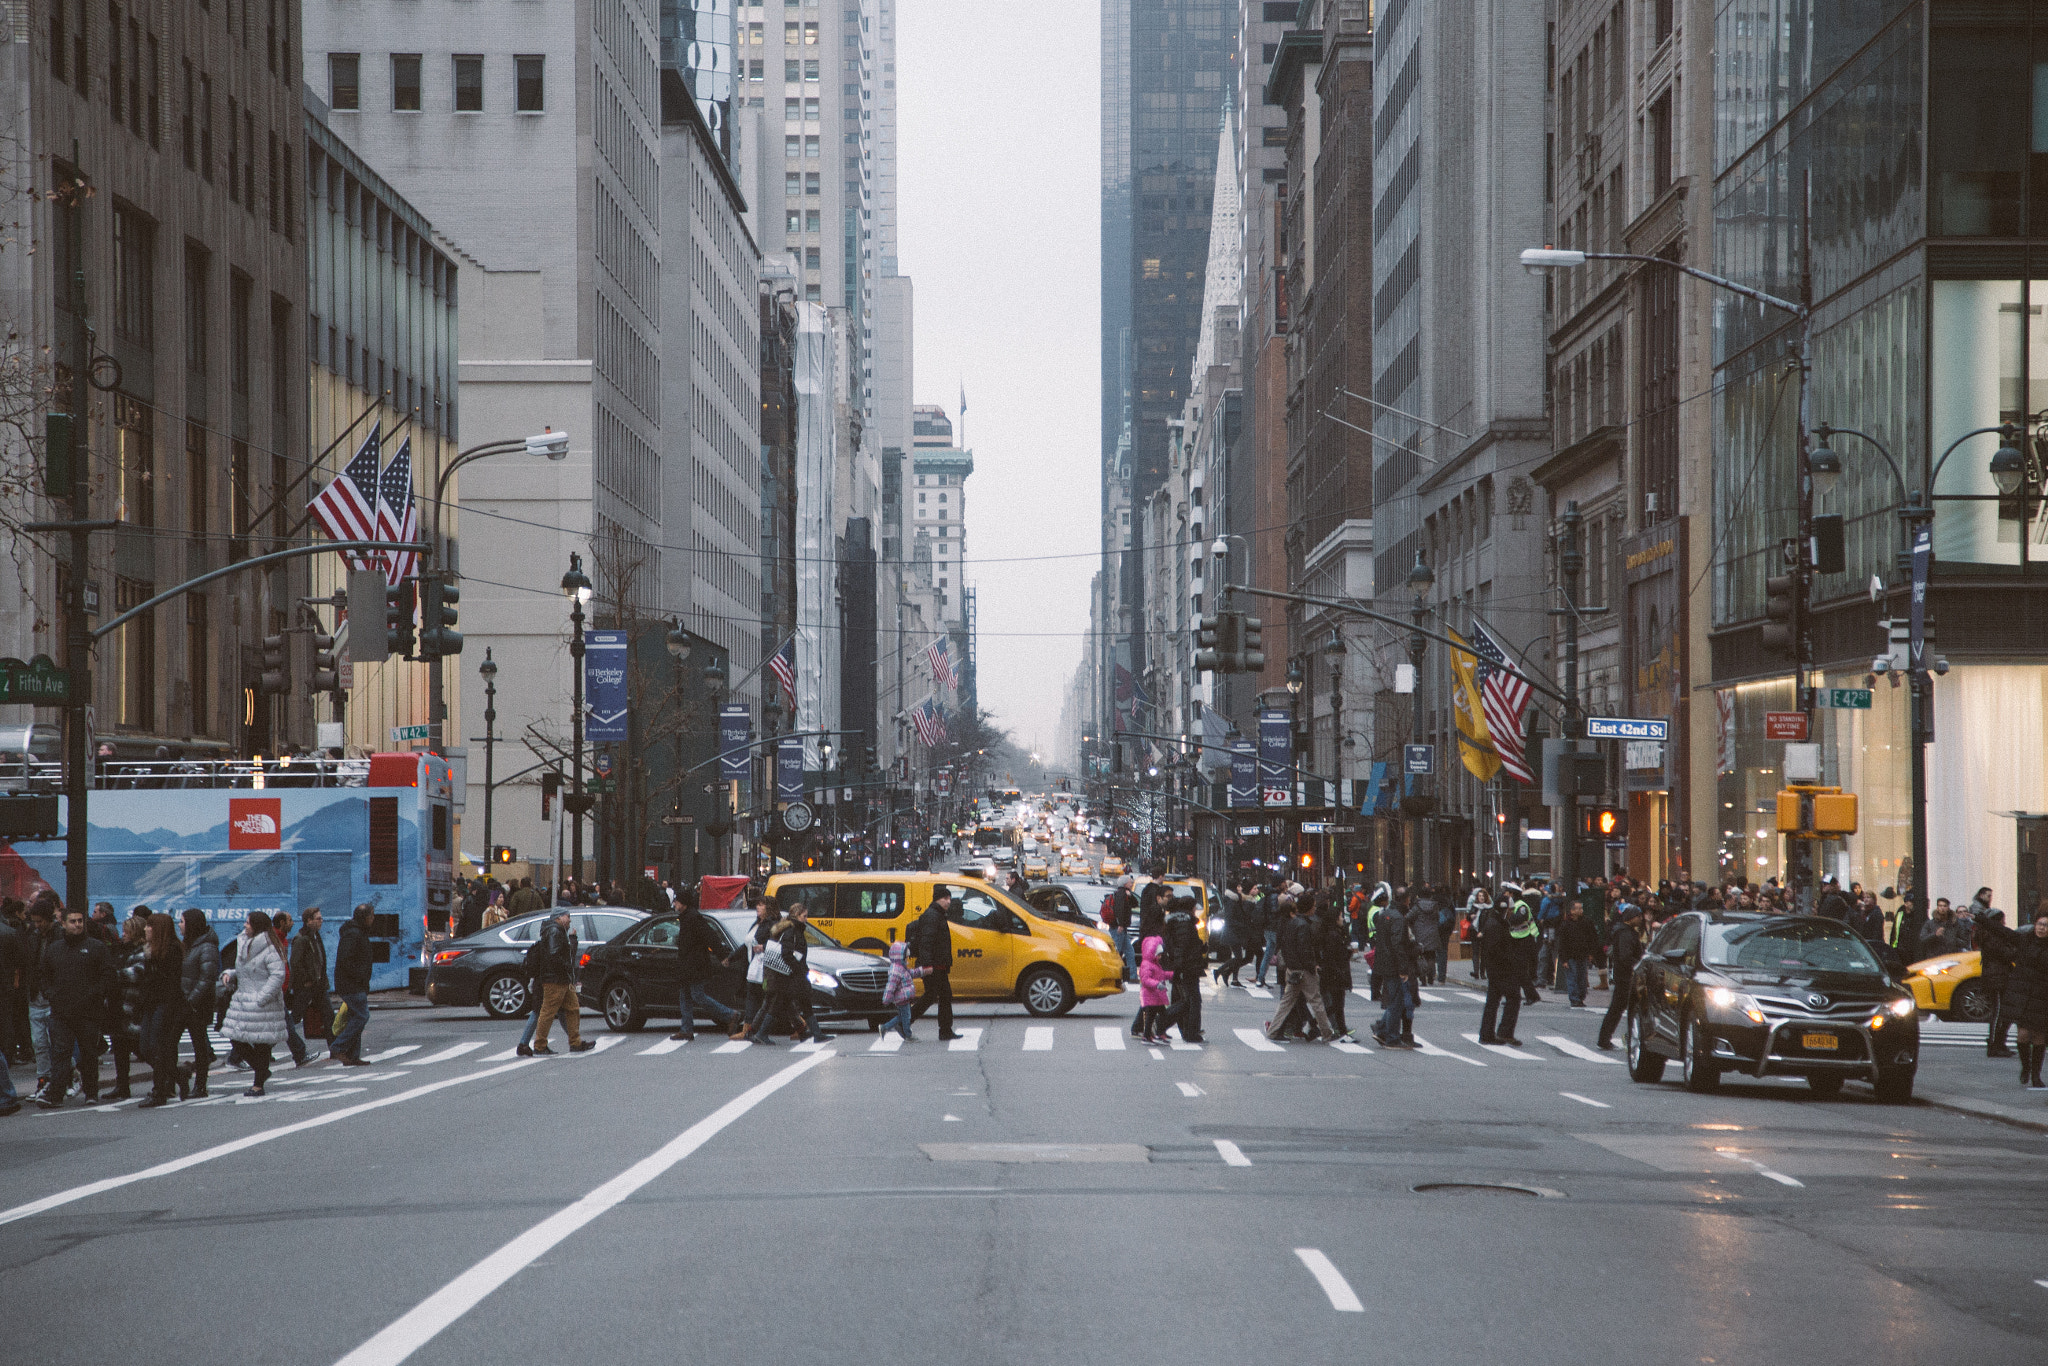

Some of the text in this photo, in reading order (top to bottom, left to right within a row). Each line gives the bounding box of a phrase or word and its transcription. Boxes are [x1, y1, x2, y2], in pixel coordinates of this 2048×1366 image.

[595, 667, 624, 678] Berkeley
[19, 674, 42, 692] Fifth
[45, 676, 63, 693] Ave
[596, 675, 622, 685] College
[1833, 691, 1840, 706] E
[1842, 691, 1858, 707] 42
[1858, 692, 1869, 700] ST
[401, 728, 409, 739] W
[409, 727, 421, 738] 42
[1591, 721, 1664, 737] East 42nd St
[245, 813, 262, 821] THE
[233, 820, 261, 828] NORTH
[1304, 824, 1316, 832] East
[217, 908, 251, 920] WEST
[957, 948, 982, 958] NYC
